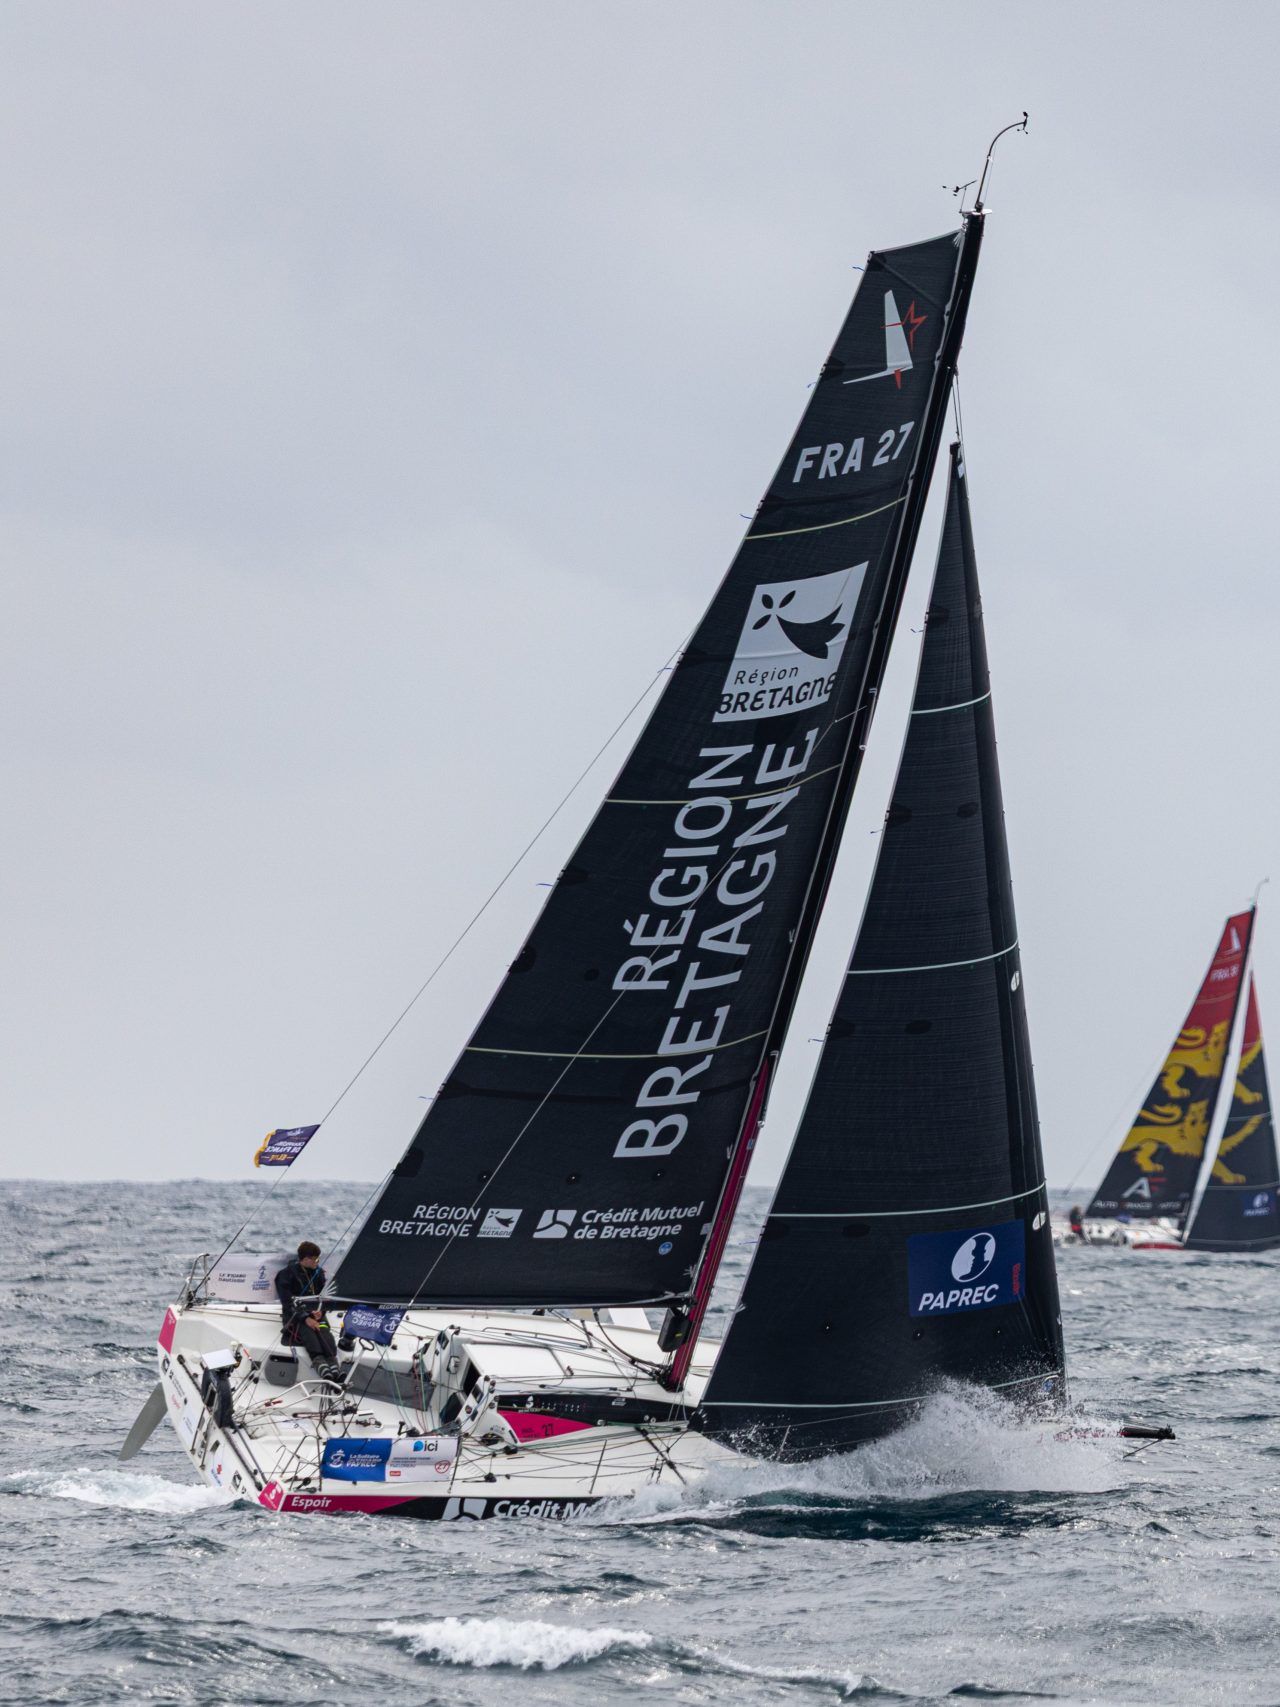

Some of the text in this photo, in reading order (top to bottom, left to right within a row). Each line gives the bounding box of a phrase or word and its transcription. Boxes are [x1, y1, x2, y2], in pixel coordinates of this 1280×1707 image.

[793, 420, 915, 483] FRA 27
[733, 665, 799, 685] Région
[612, 744, 753, 991] RÉGION
[612, 727, 819, 1158] BRETAGNE
[412, 1203, 481, 1220] RÉGION
[581, 1201, 705, 1224] Crédit Mutuel
[378, 1220, 473, 1237] BRETAGNE
[573, 1222, 682, 1240] de Bretagne
[918, 1283, 1000, 1312] PAPREC
[542, 1423, 555, 1437] 27
[424, 1440, 438, 1452] ici
[291, 1496, 332, 1510] Espoir
[493, 1499, 561, 1519] Crédit
